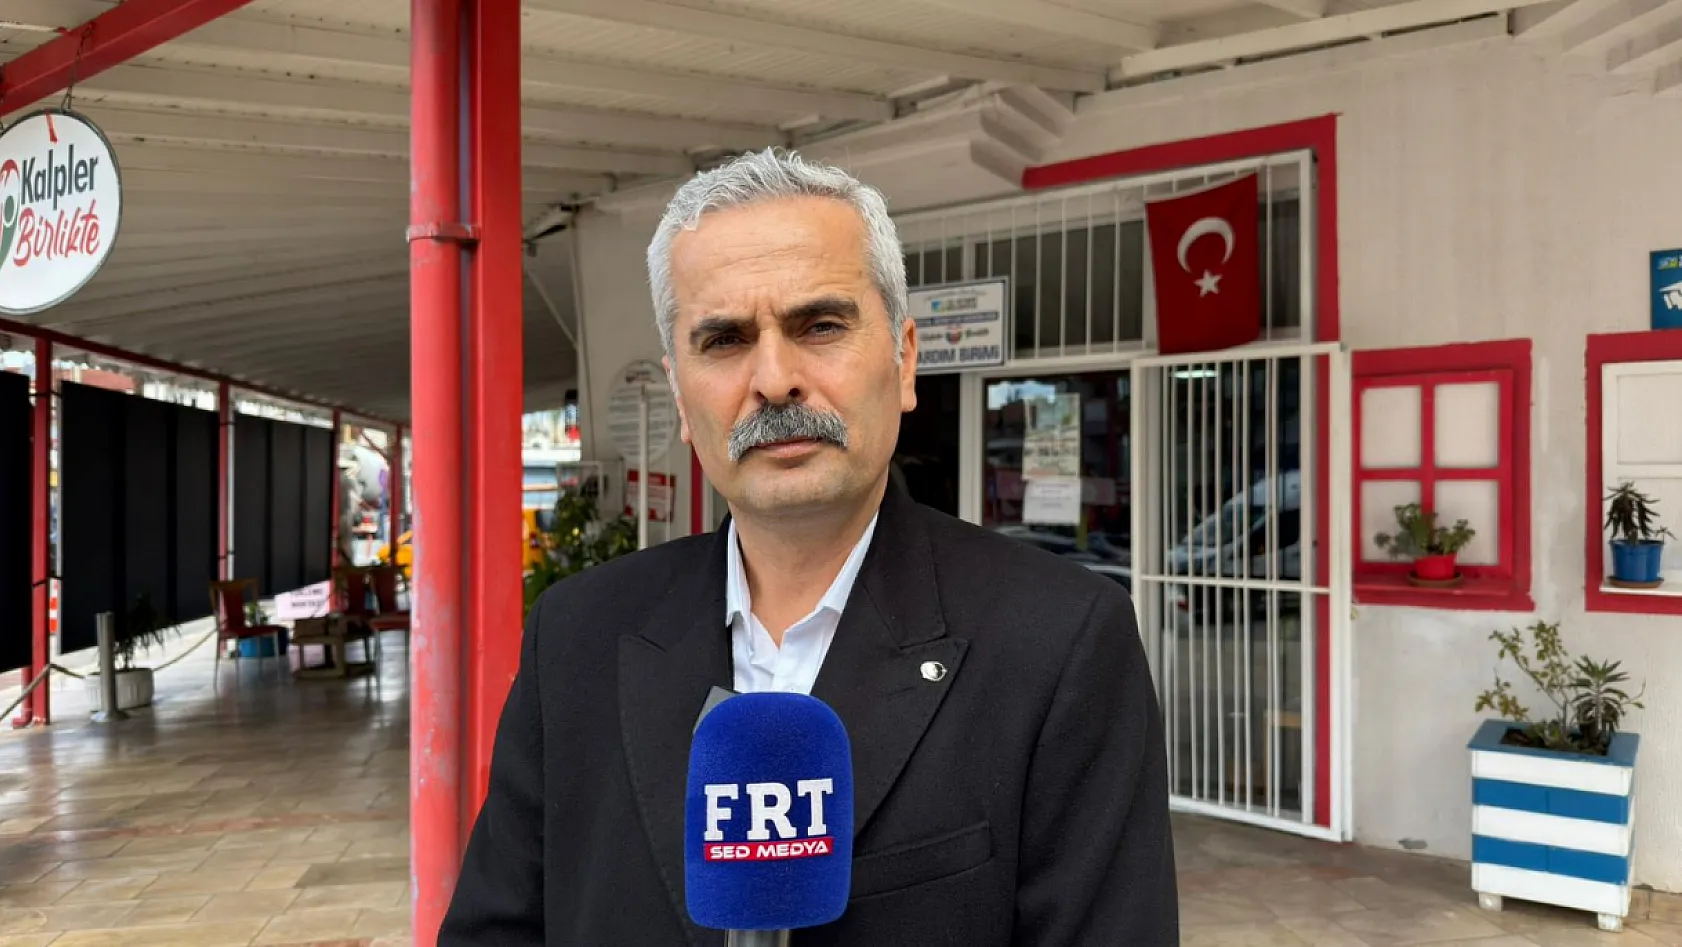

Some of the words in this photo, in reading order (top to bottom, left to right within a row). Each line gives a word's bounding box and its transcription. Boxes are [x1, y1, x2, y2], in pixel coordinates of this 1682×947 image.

[22, 144, 98, 210] Kalpler
[14, 199, 100, 266] Birlikte
[704, 778, 833, 841] FRT
[710, 845, 750, 859] SED
[757, 841, 829, 858] MEDYA
